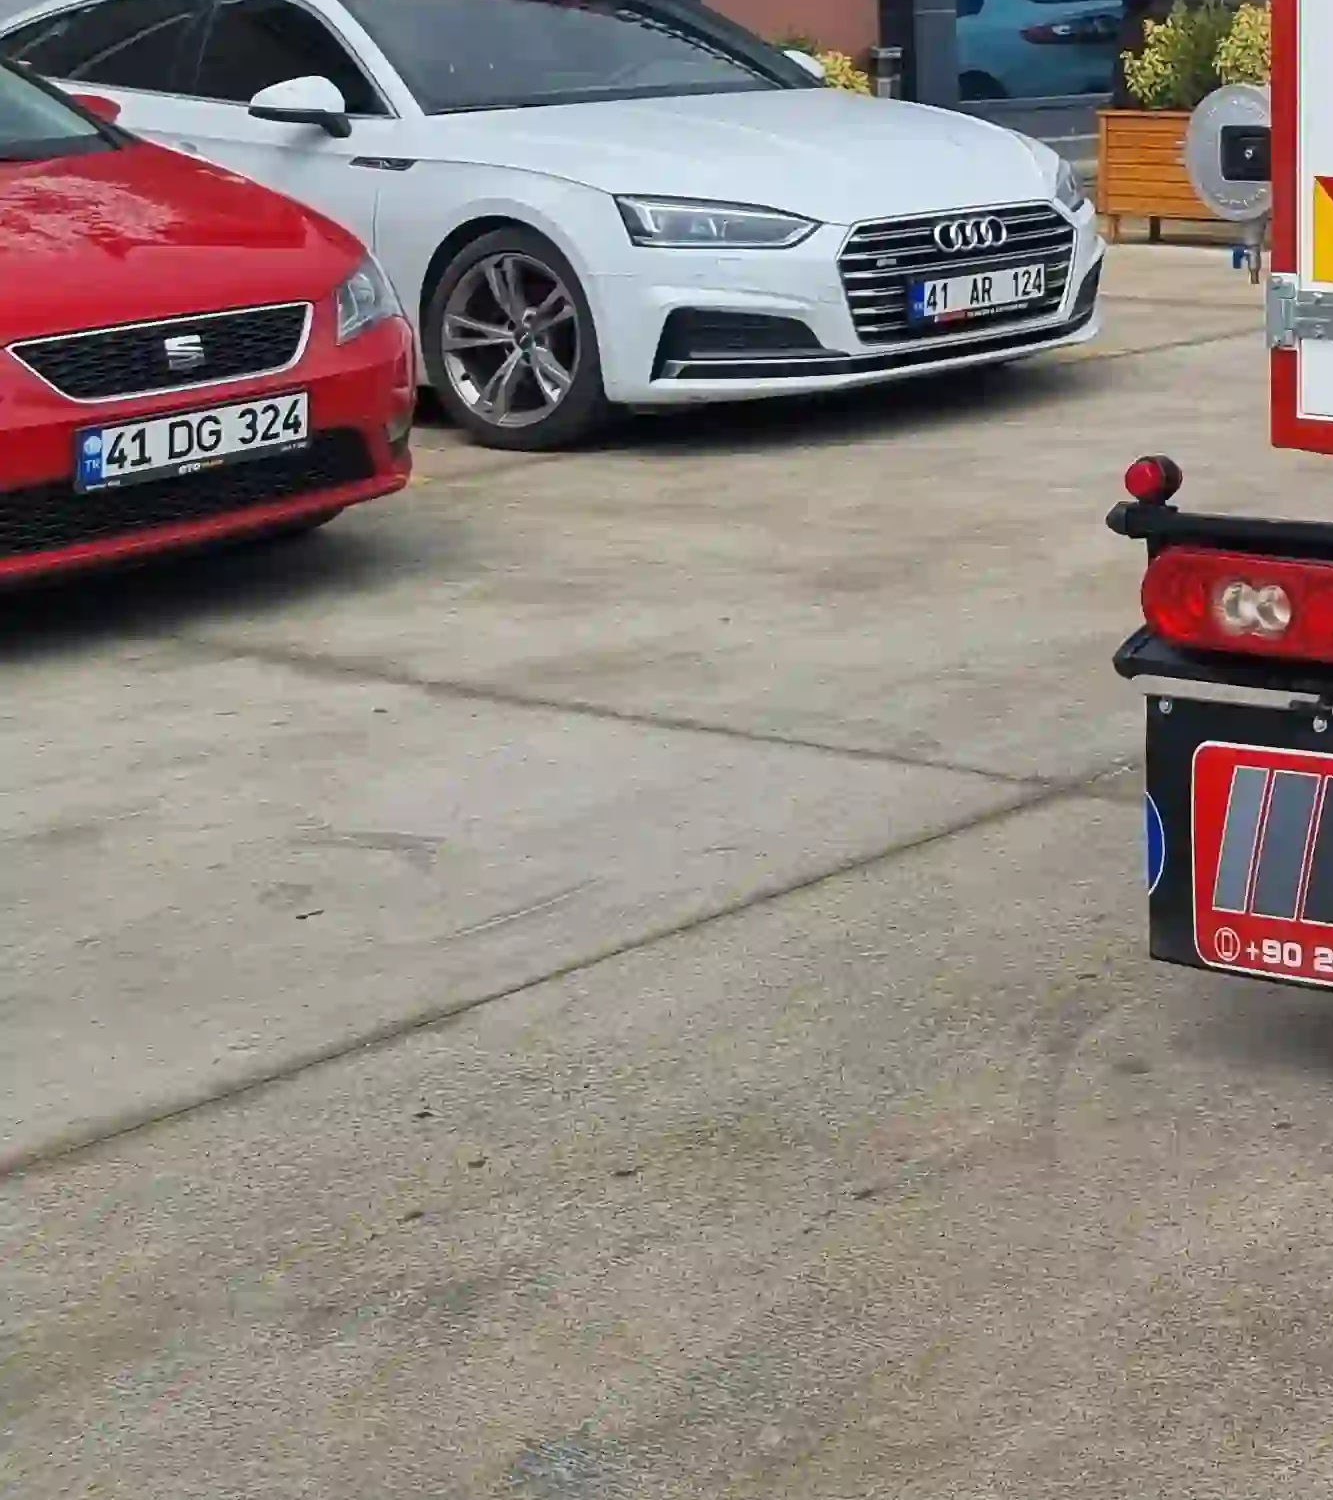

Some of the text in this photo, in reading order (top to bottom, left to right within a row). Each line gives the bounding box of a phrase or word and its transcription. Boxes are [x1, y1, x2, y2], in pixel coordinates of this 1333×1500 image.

[926, 267, 1042, 311] 41 AR 124
[106, 399, 301, 468] 41 DG 324
[1246, 938, 1302, 968] +90
